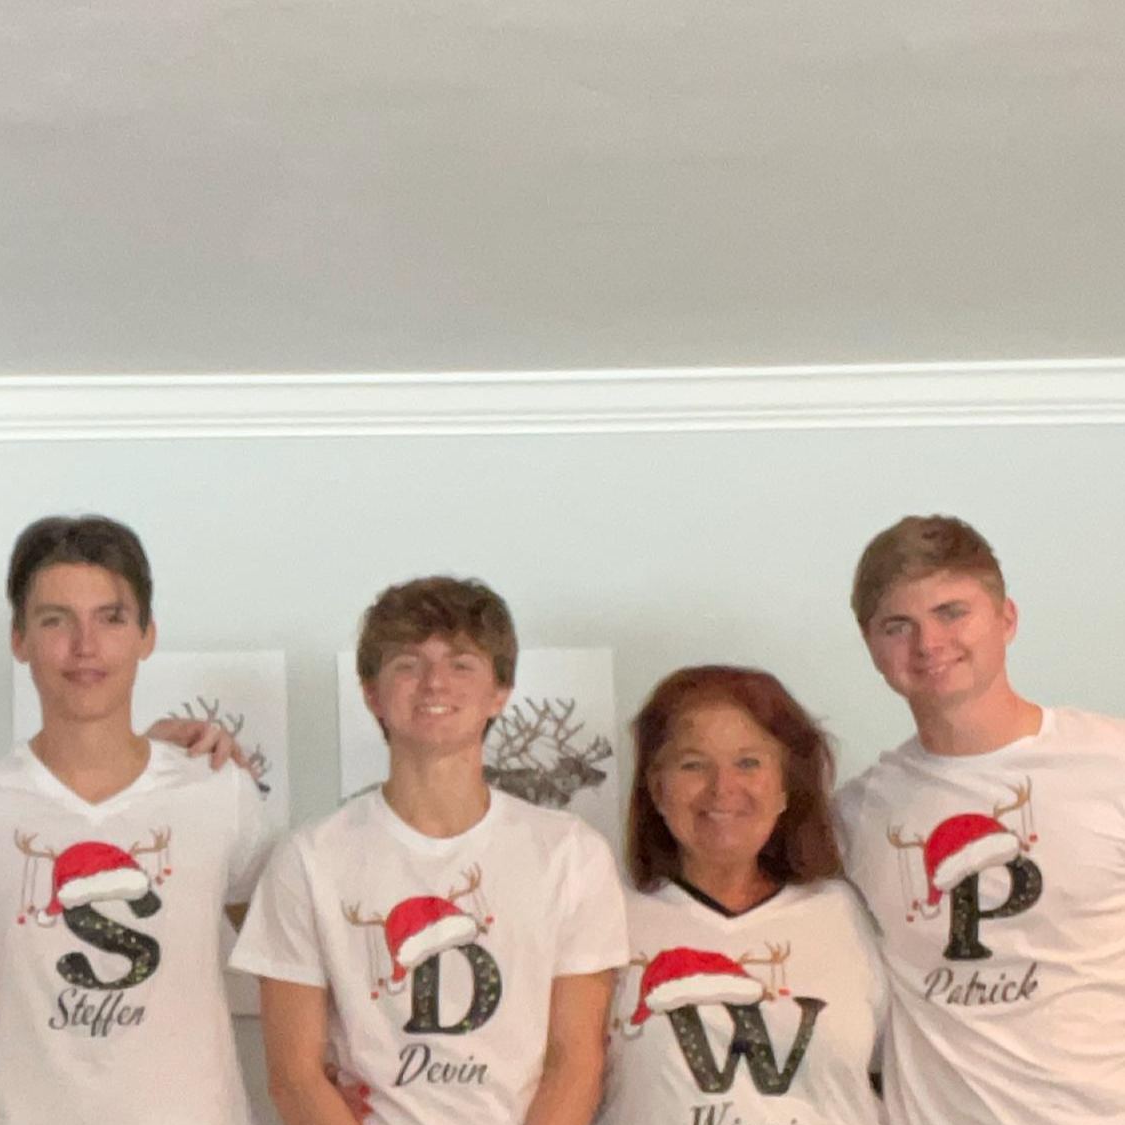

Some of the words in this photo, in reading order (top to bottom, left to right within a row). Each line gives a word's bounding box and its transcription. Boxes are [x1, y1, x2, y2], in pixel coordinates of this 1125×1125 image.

[55, 888, 163, 991] S
[943, 853, 1043, 961] P
[48, 988, 145, 1038] Steffen
[403, 941, 503, 1035] D
[923, 961, 1039, 1007] Patrick
[393, 1042, 488, 1088] Devin
[665, 996, 828, 1097] W
